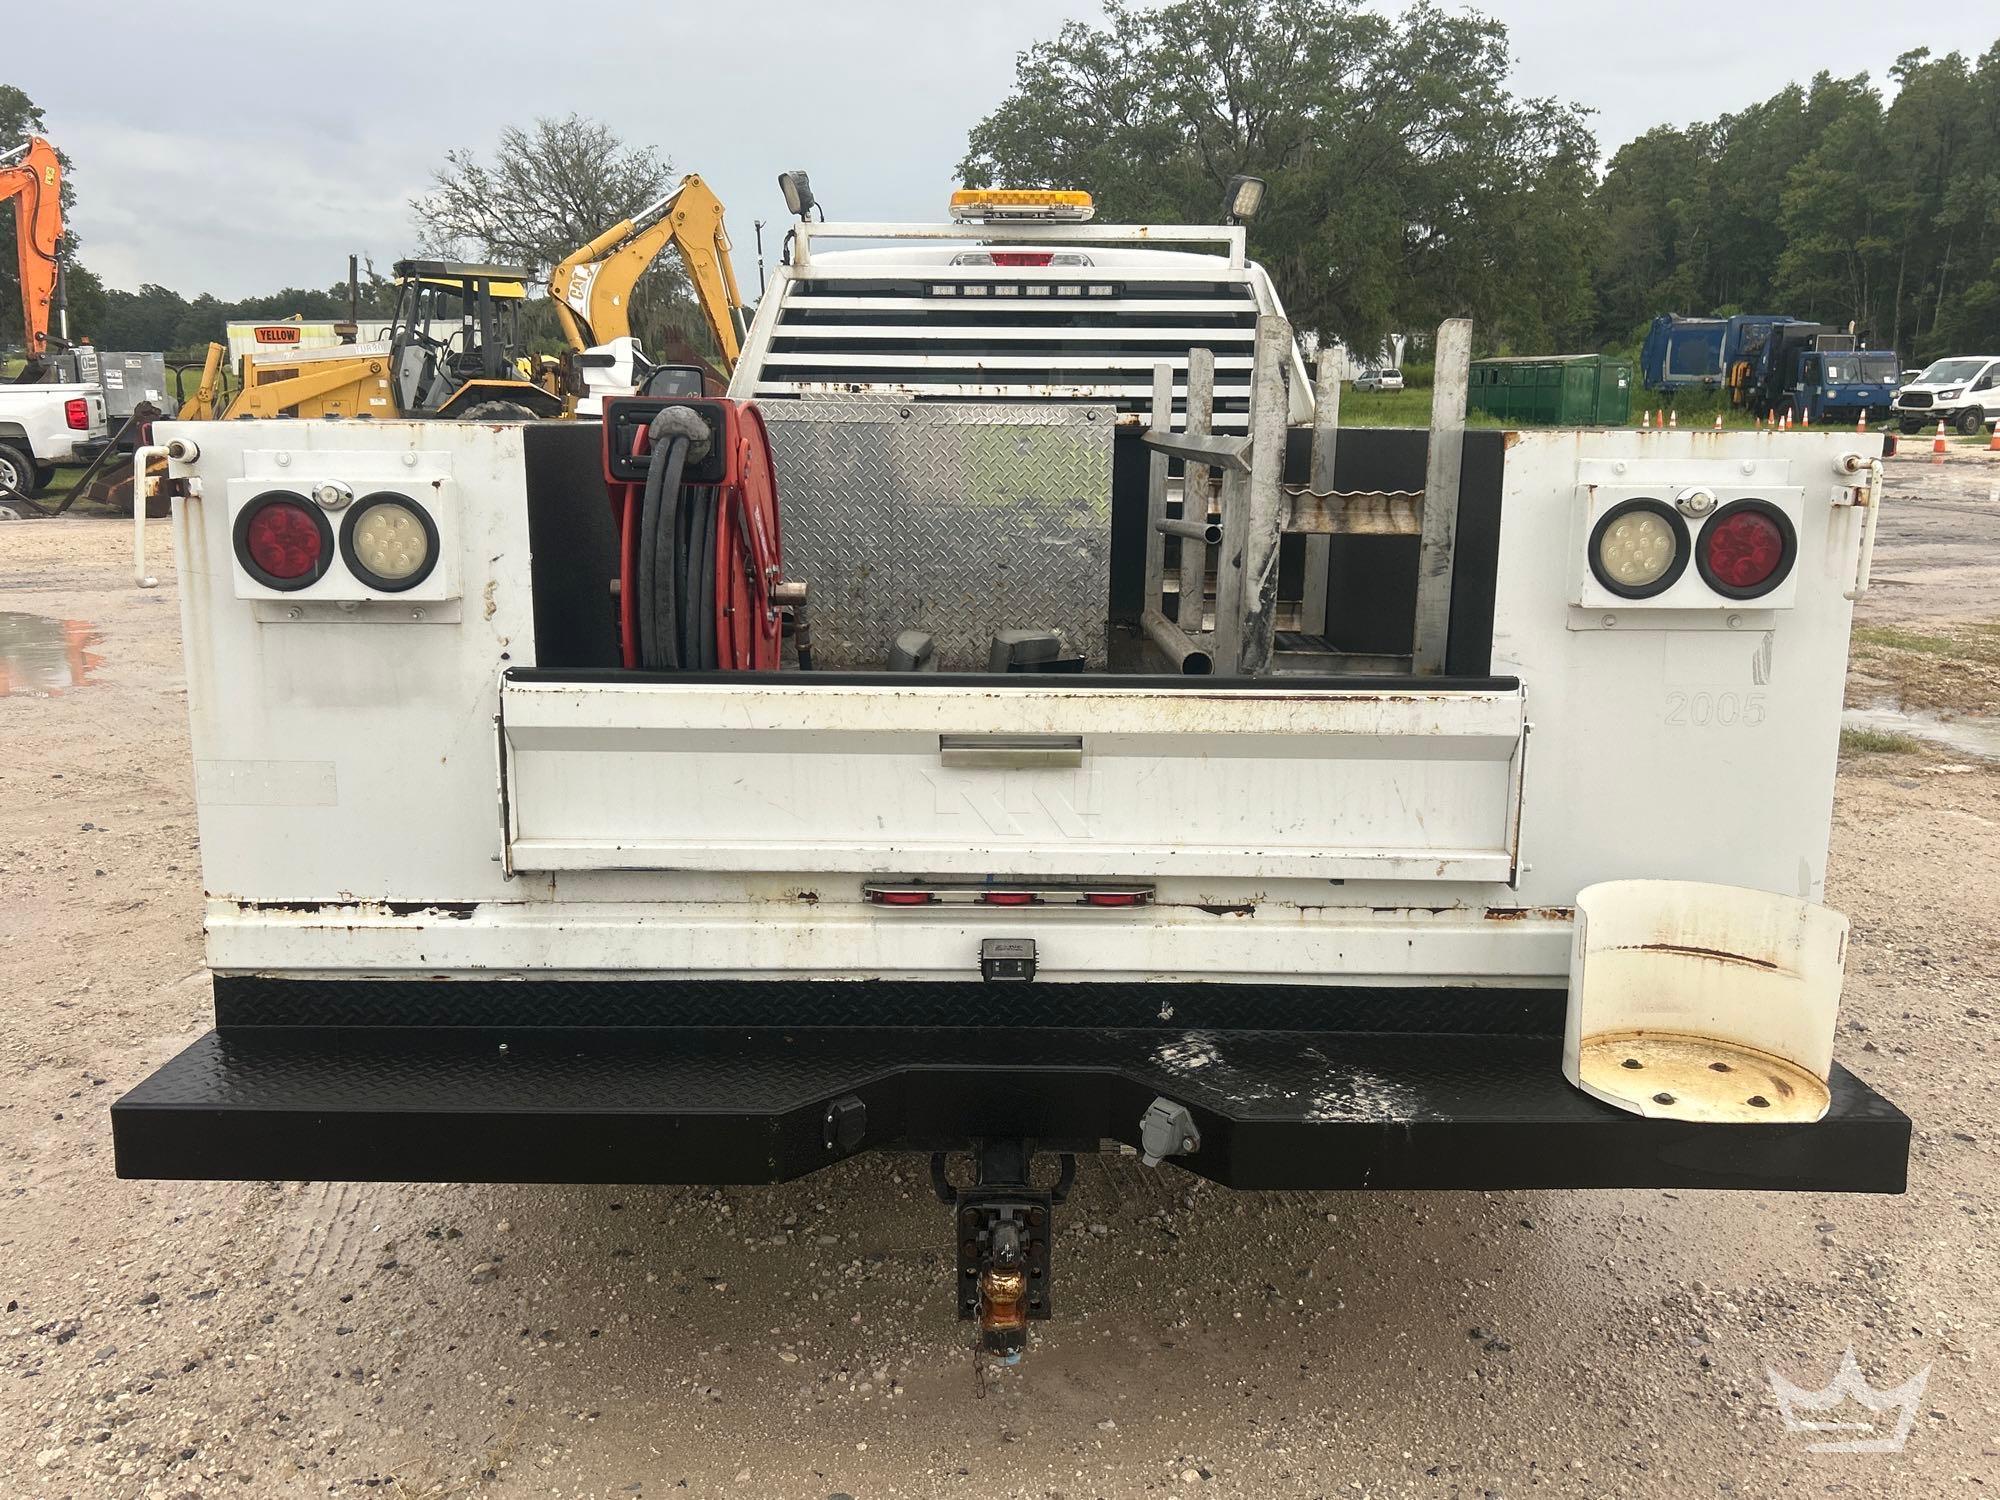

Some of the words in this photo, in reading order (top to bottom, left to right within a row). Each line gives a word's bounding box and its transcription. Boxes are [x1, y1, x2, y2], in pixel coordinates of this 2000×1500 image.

[570, 272, 588, 300] CAT
[260, 330, 295, 341] YELLOW
[1664, 690, 1766, 727] 2005
